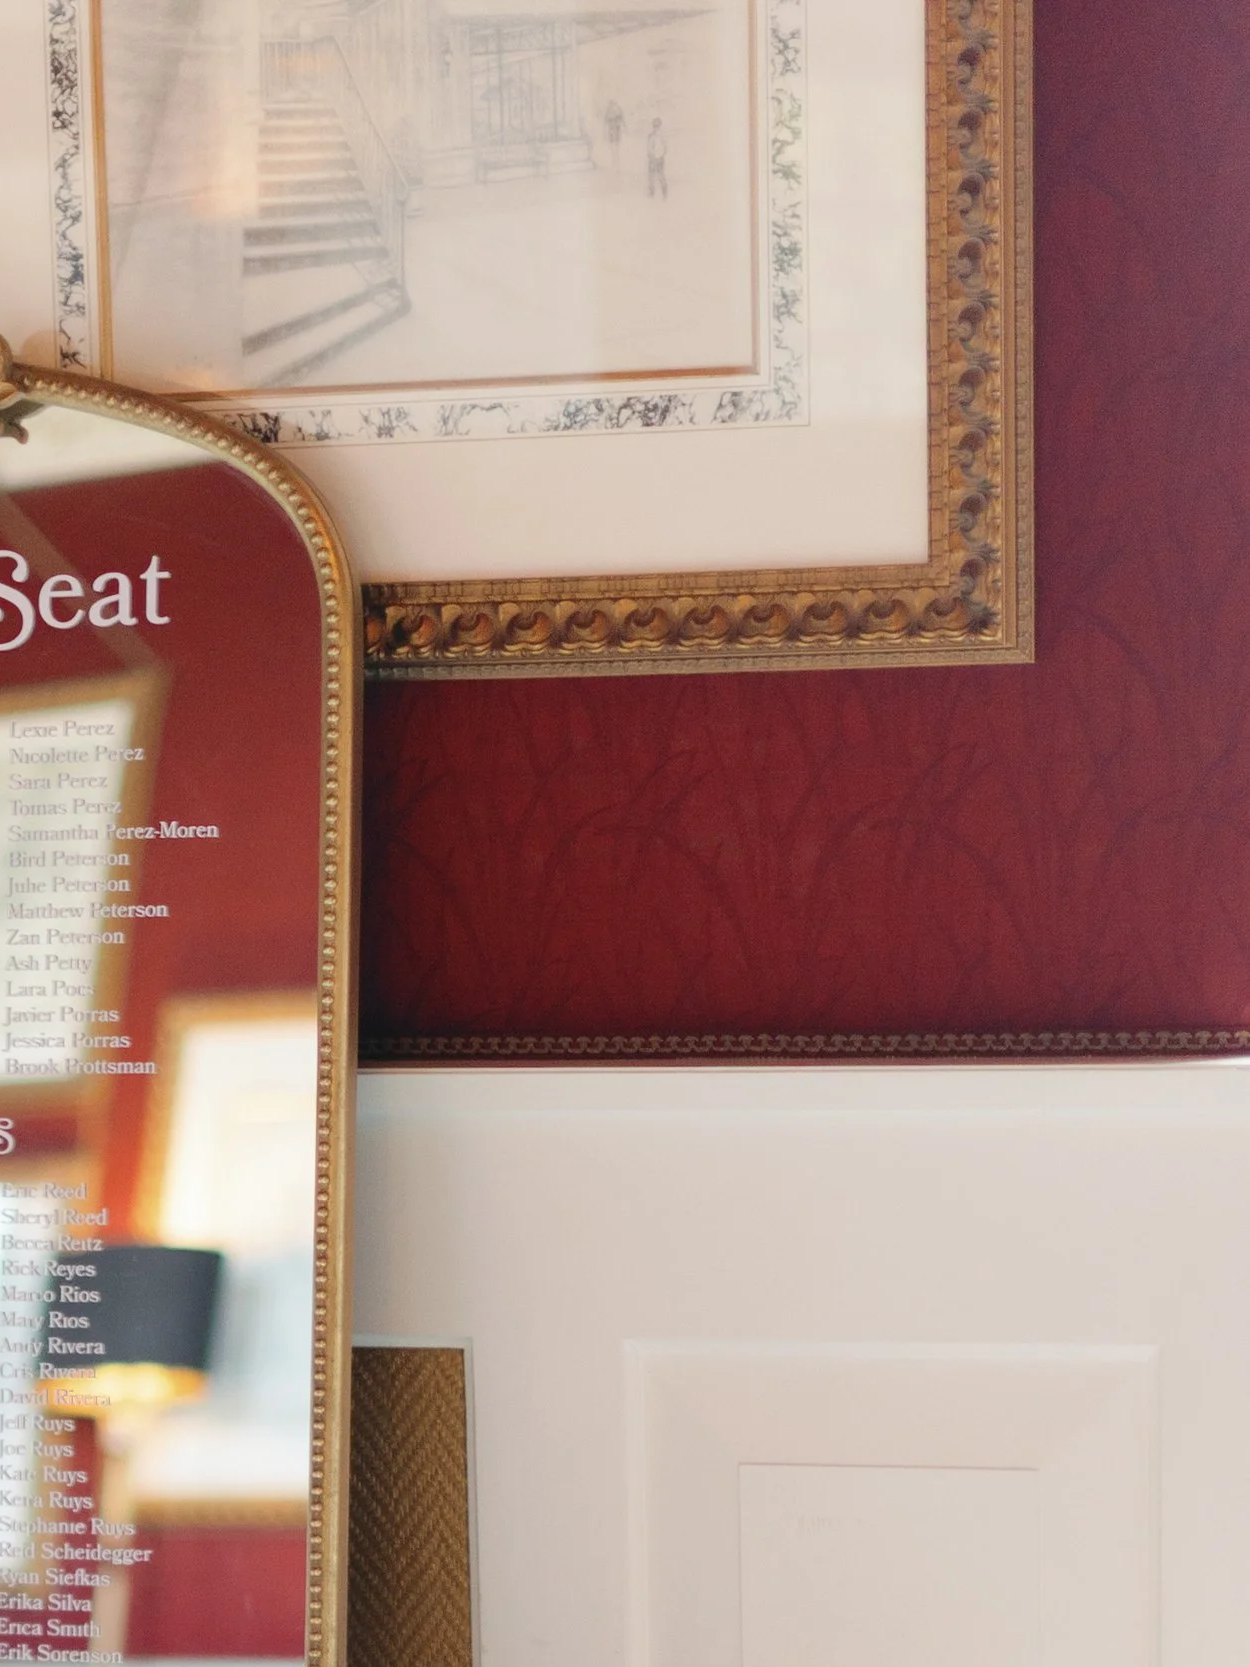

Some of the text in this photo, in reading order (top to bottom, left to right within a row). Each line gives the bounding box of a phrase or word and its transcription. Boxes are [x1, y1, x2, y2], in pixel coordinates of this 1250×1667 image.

[10, 721, 58, 739] Lexie
[62, 720, 115, 737] Perez
[8, 825, 99, 842] Samantha
[106, 822, 219, 840] Perez-Moren
[8, 903, 84, 919] Matthew
[89, 902, 169, 918] Peterson
[4, 1032, 65, 1052] Jessica
[71, 1032, 132, 1048] Porras
[6, 1059, 58, 1075] Brook
[64, 1059, 157, 1075] Prottsman
[48, 1592, 92, 1612] Silva
[38, 1644, 123, 1664] Sorenson
